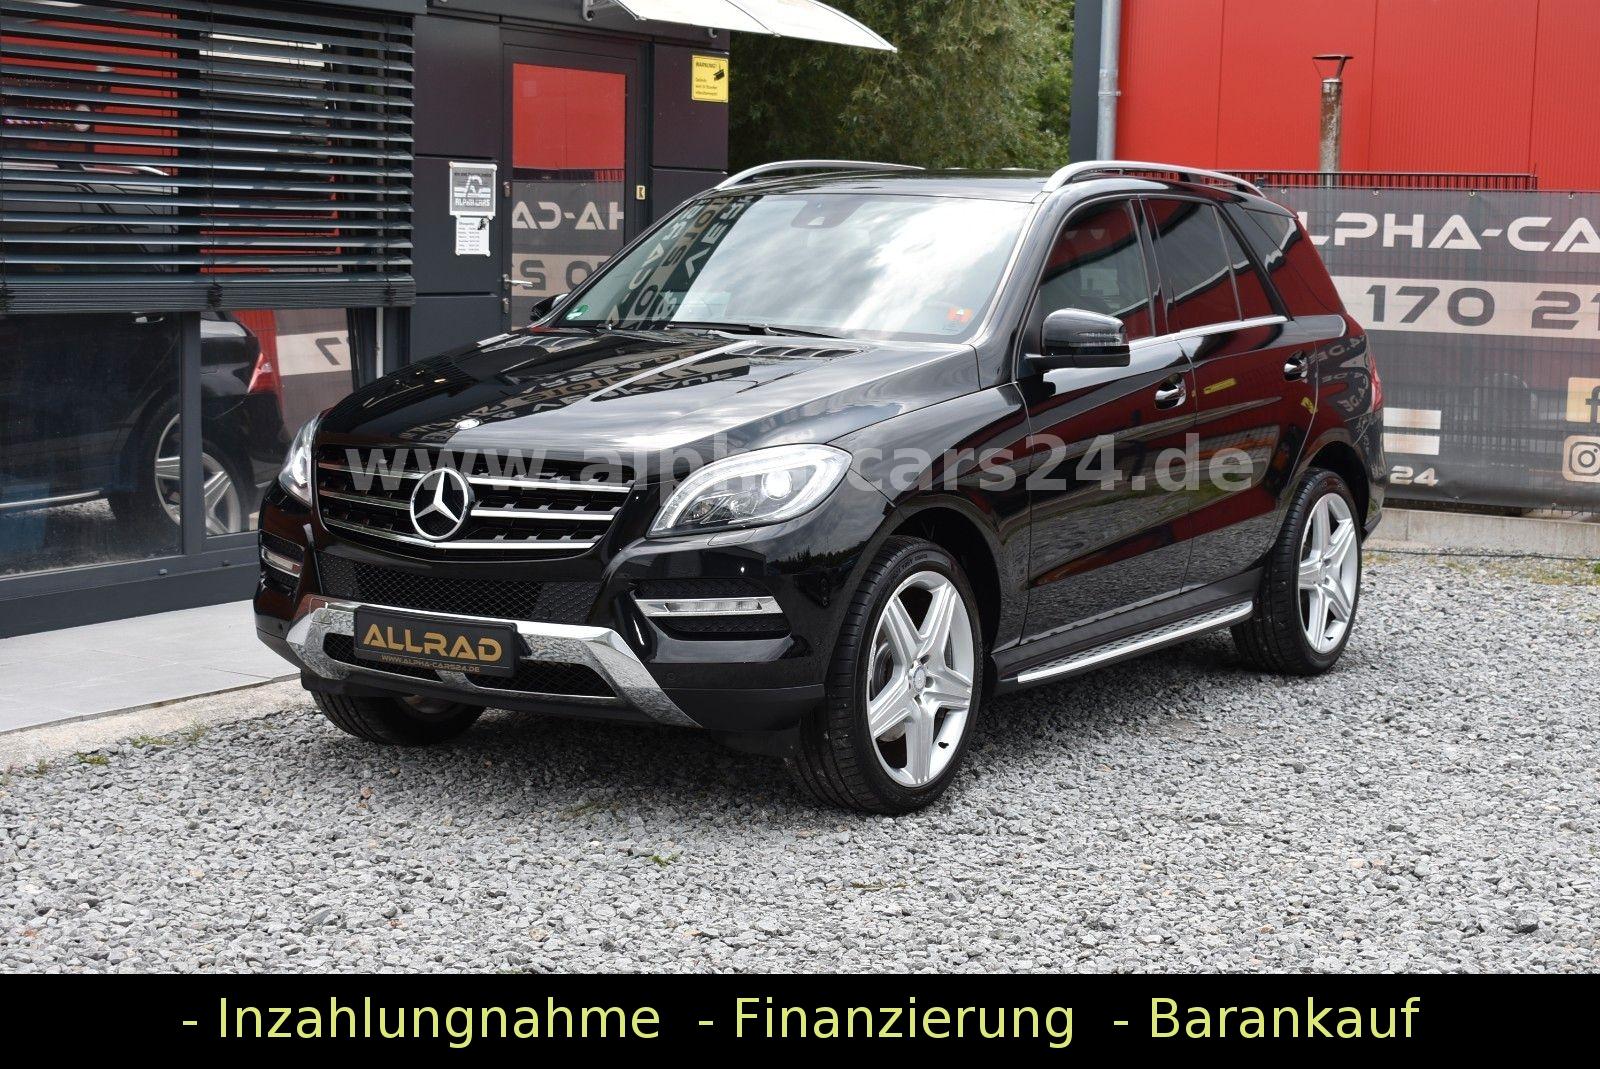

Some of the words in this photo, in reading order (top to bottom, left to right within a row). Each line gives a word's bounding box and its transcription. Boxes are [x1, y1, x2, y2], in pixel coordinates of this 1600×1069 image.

[1366, 284, 1496, 327] 170
[1389, 465, 1439, 487] 24
[363, 623, 502, 662] ALLRAD
[380, 654, 480, 673] WWW.ALPHA-CARS24.DE
